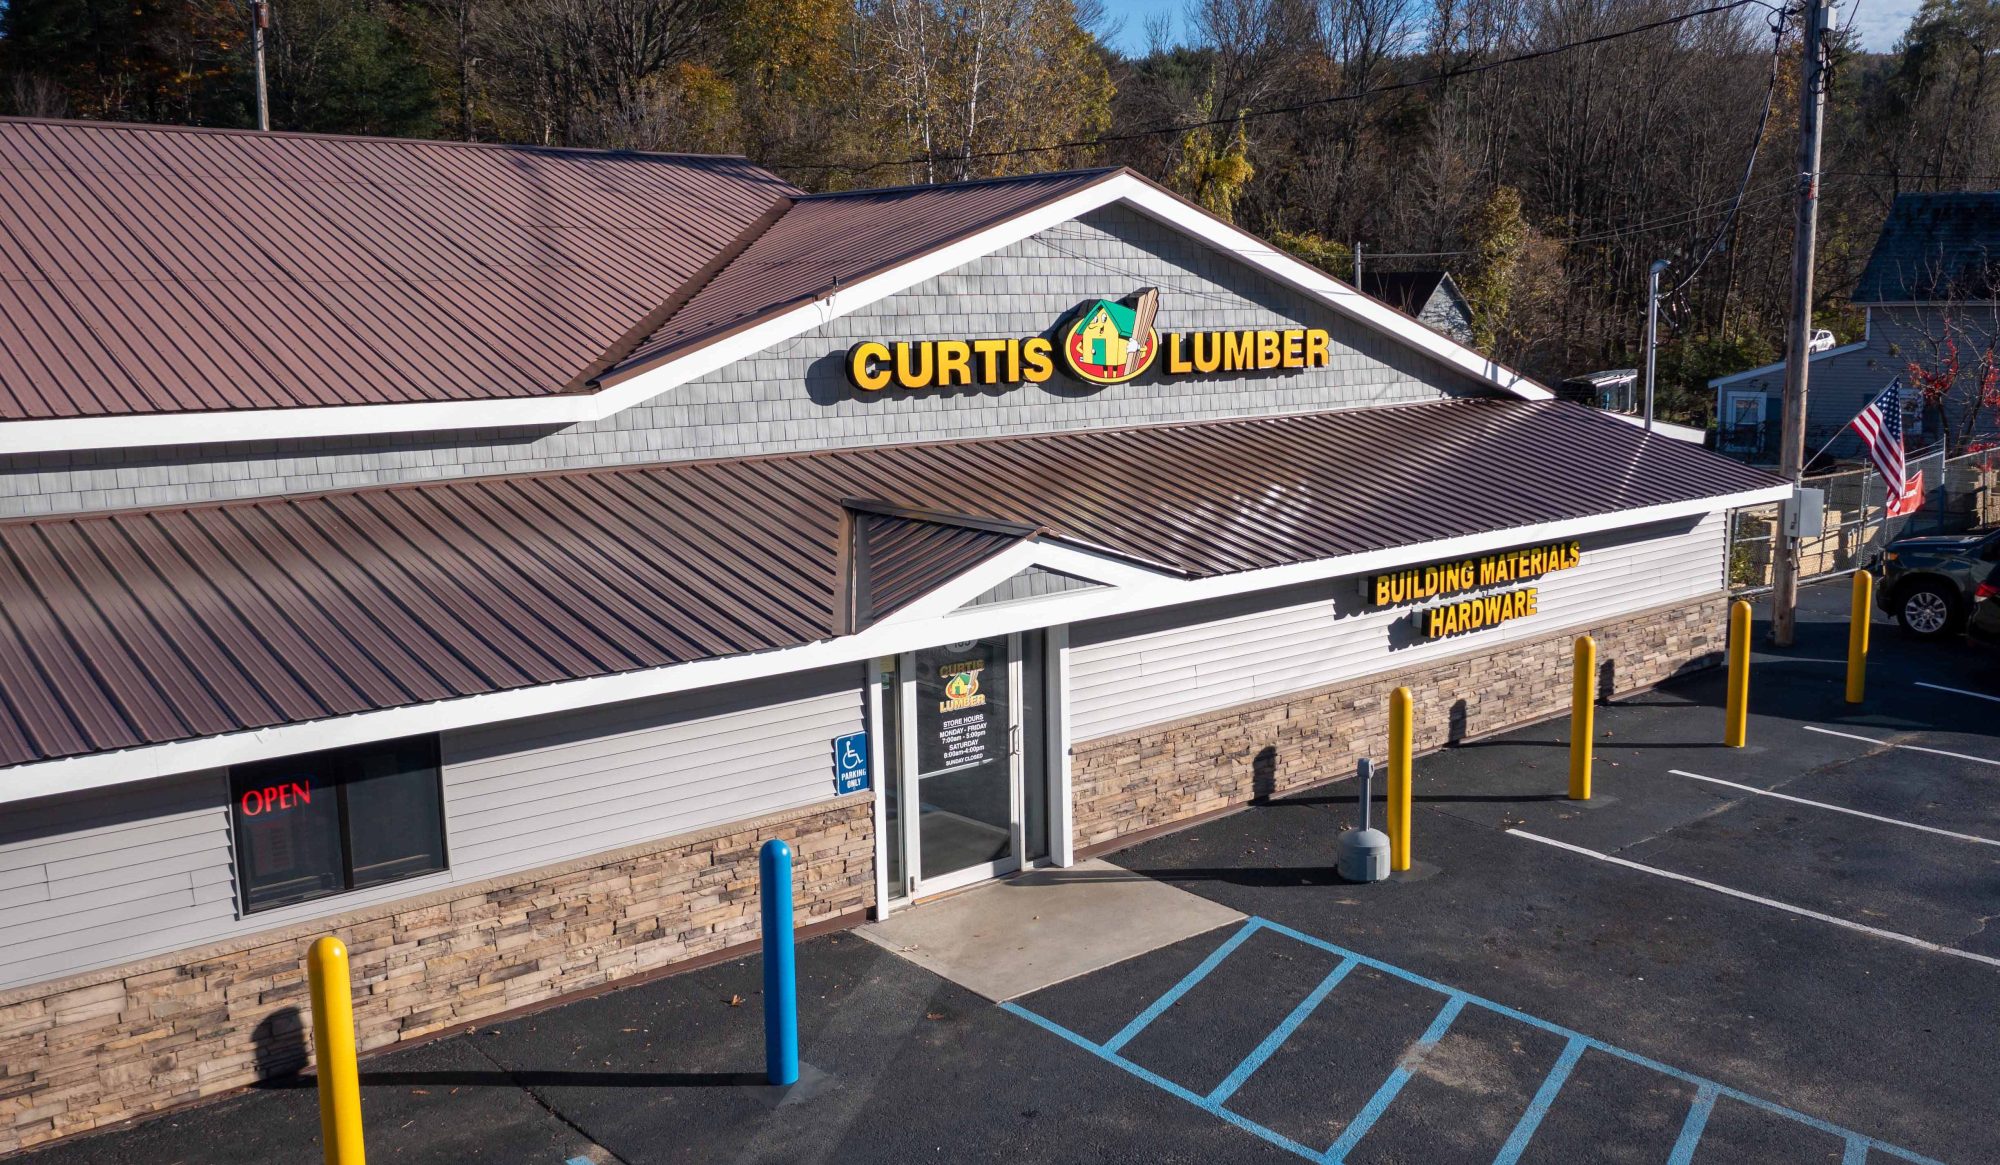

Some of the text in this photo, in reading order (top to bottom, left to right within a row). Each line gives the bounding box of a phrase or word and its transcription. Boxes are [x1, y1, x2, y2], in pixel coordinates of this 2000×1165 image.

[851, 328, 1330, 390] CURTIS LUMBER
[1376, 540, 1581, 606] BUILDING MATERIALS
[1429, 587, 1538, 638] HARDWARE
[940, 660, 984, 678] CURTIS
[940, 695, 986, 713] LUMBER
[943, 714, 983, 727] STORE HOURS
[940, 728, 963, 738] MONDAY
[968, 722, 987, 732] FRIDAY
[949, 739, 978, 750] SATURDAY
[946, 753, 983, 766] SUNDAY CLOSED
[841, 769, 866, 781] PARKING
[847, 778, 861, 788] ONLY
[241, 779, 312, 816] OPEN
